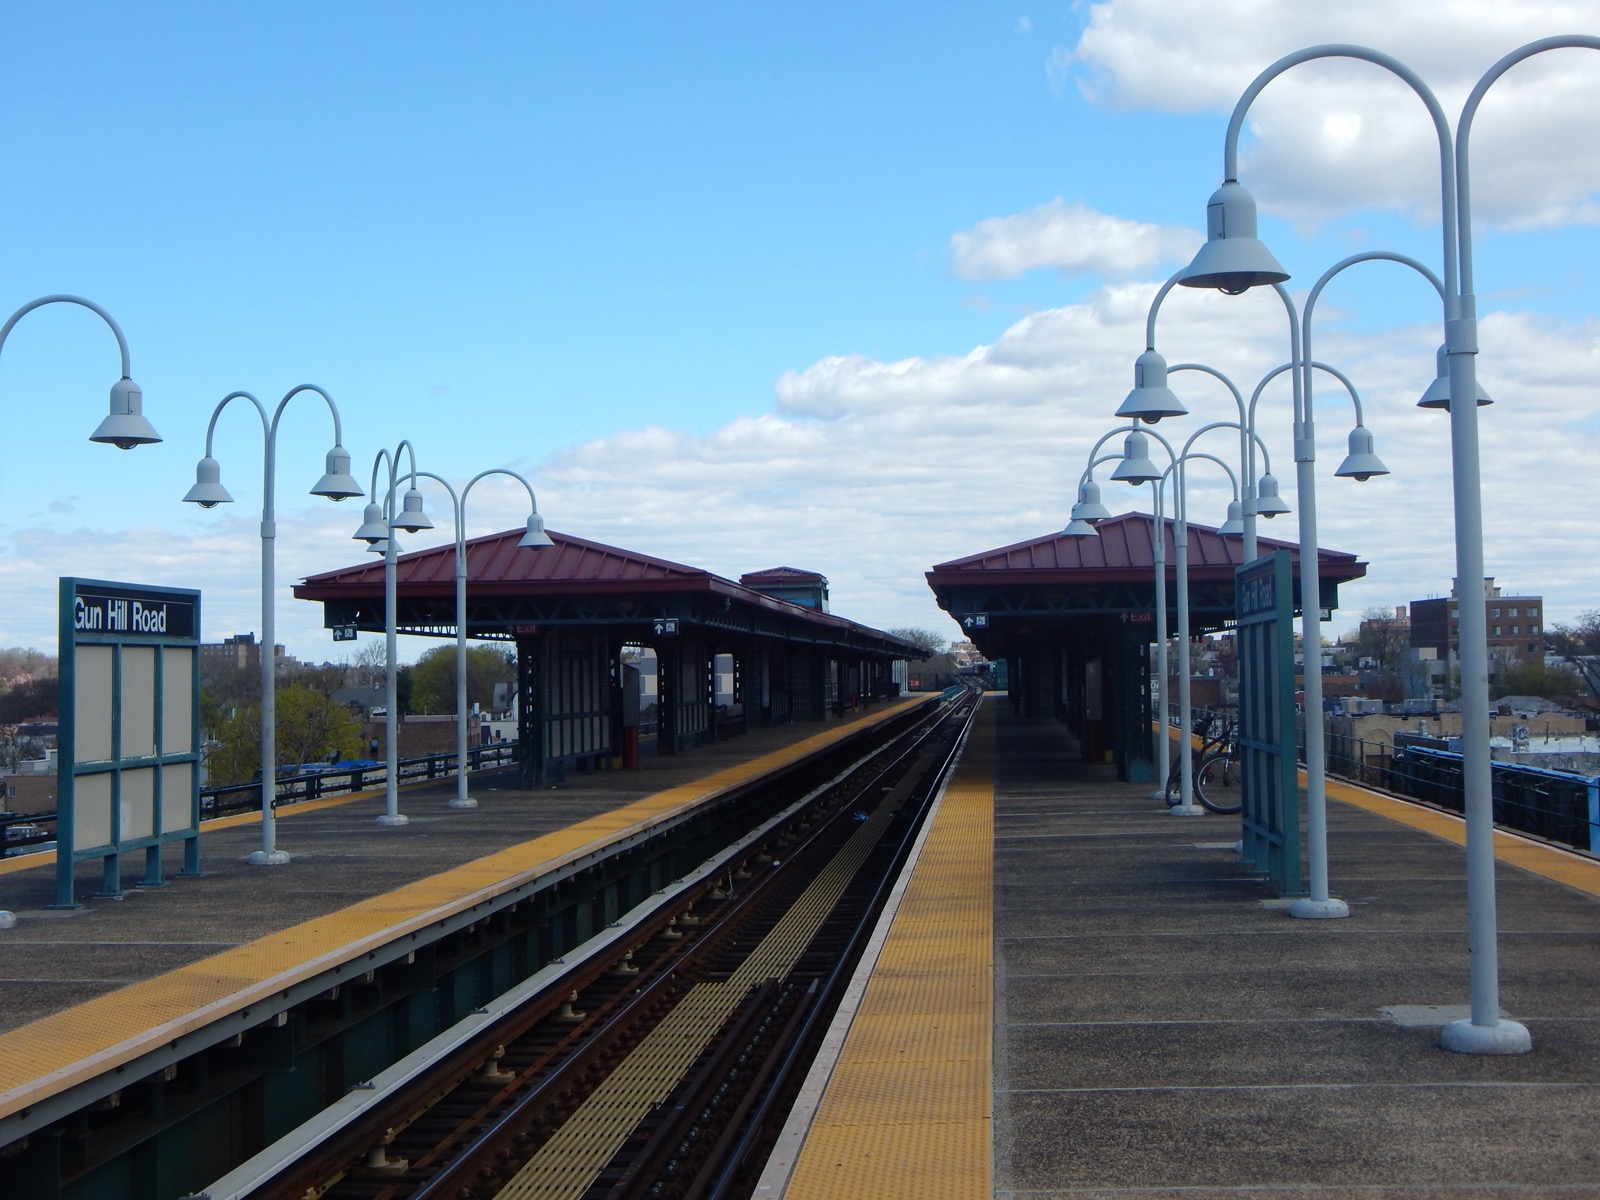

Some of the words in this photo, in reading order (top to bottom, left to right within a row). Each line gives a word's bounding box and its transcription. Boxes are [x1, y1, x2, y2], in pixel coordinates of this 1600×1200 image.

[1259, 576, 1272, 608] Road
[75, 596, 102, 630] Gun
[107, 599, 128, 631] Hill
[132, 601, 167, 632] Road
[1130, 612, 1152, 622] Exit
[516, 624, 536, 633] Exit
